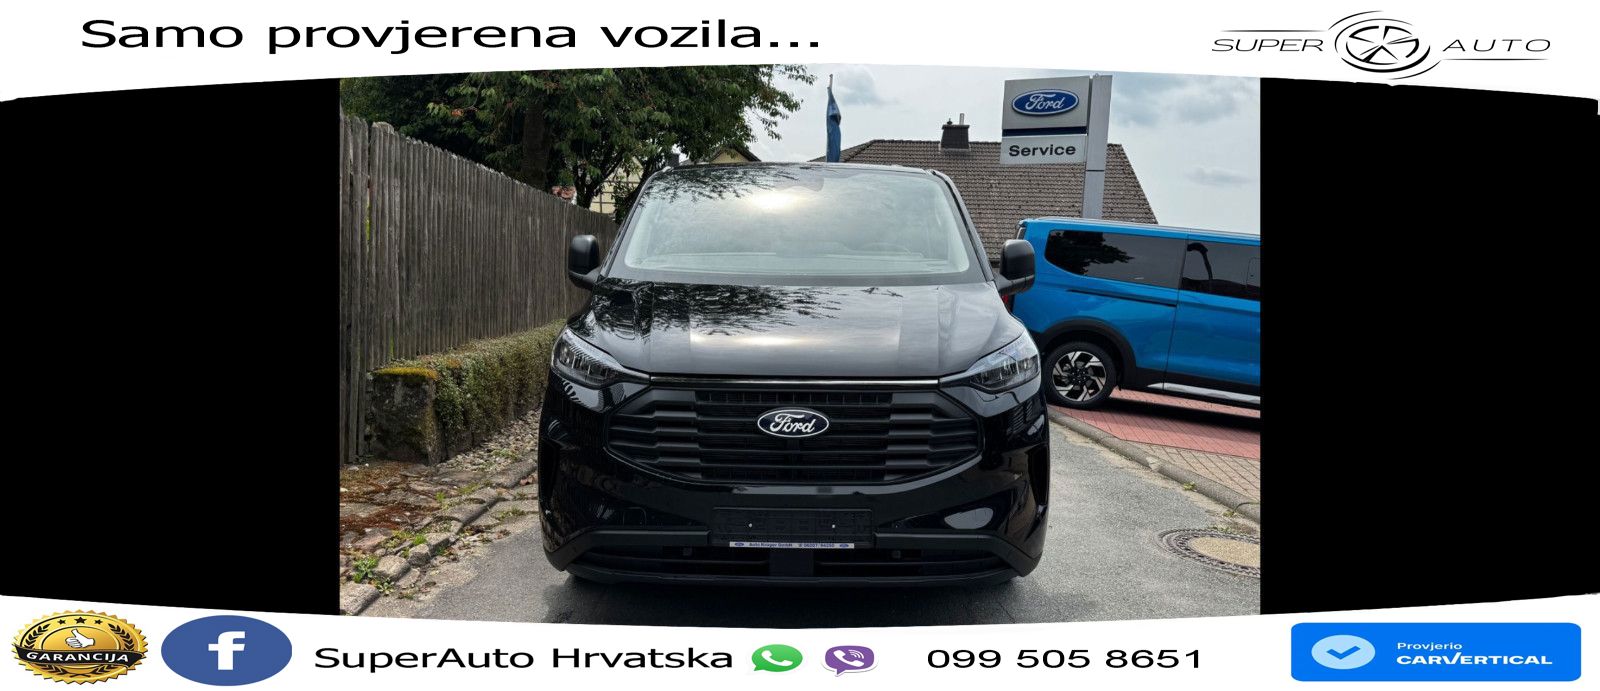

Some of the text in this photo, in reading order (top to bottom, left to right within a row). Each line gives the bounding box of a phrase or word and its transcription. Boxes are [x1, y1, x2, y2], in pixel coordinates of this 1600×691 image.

[1025, 93, 1066, 110] Ford
[1008, 144, 1076, 157] Service
[769, 413, 816, 433] Ford
